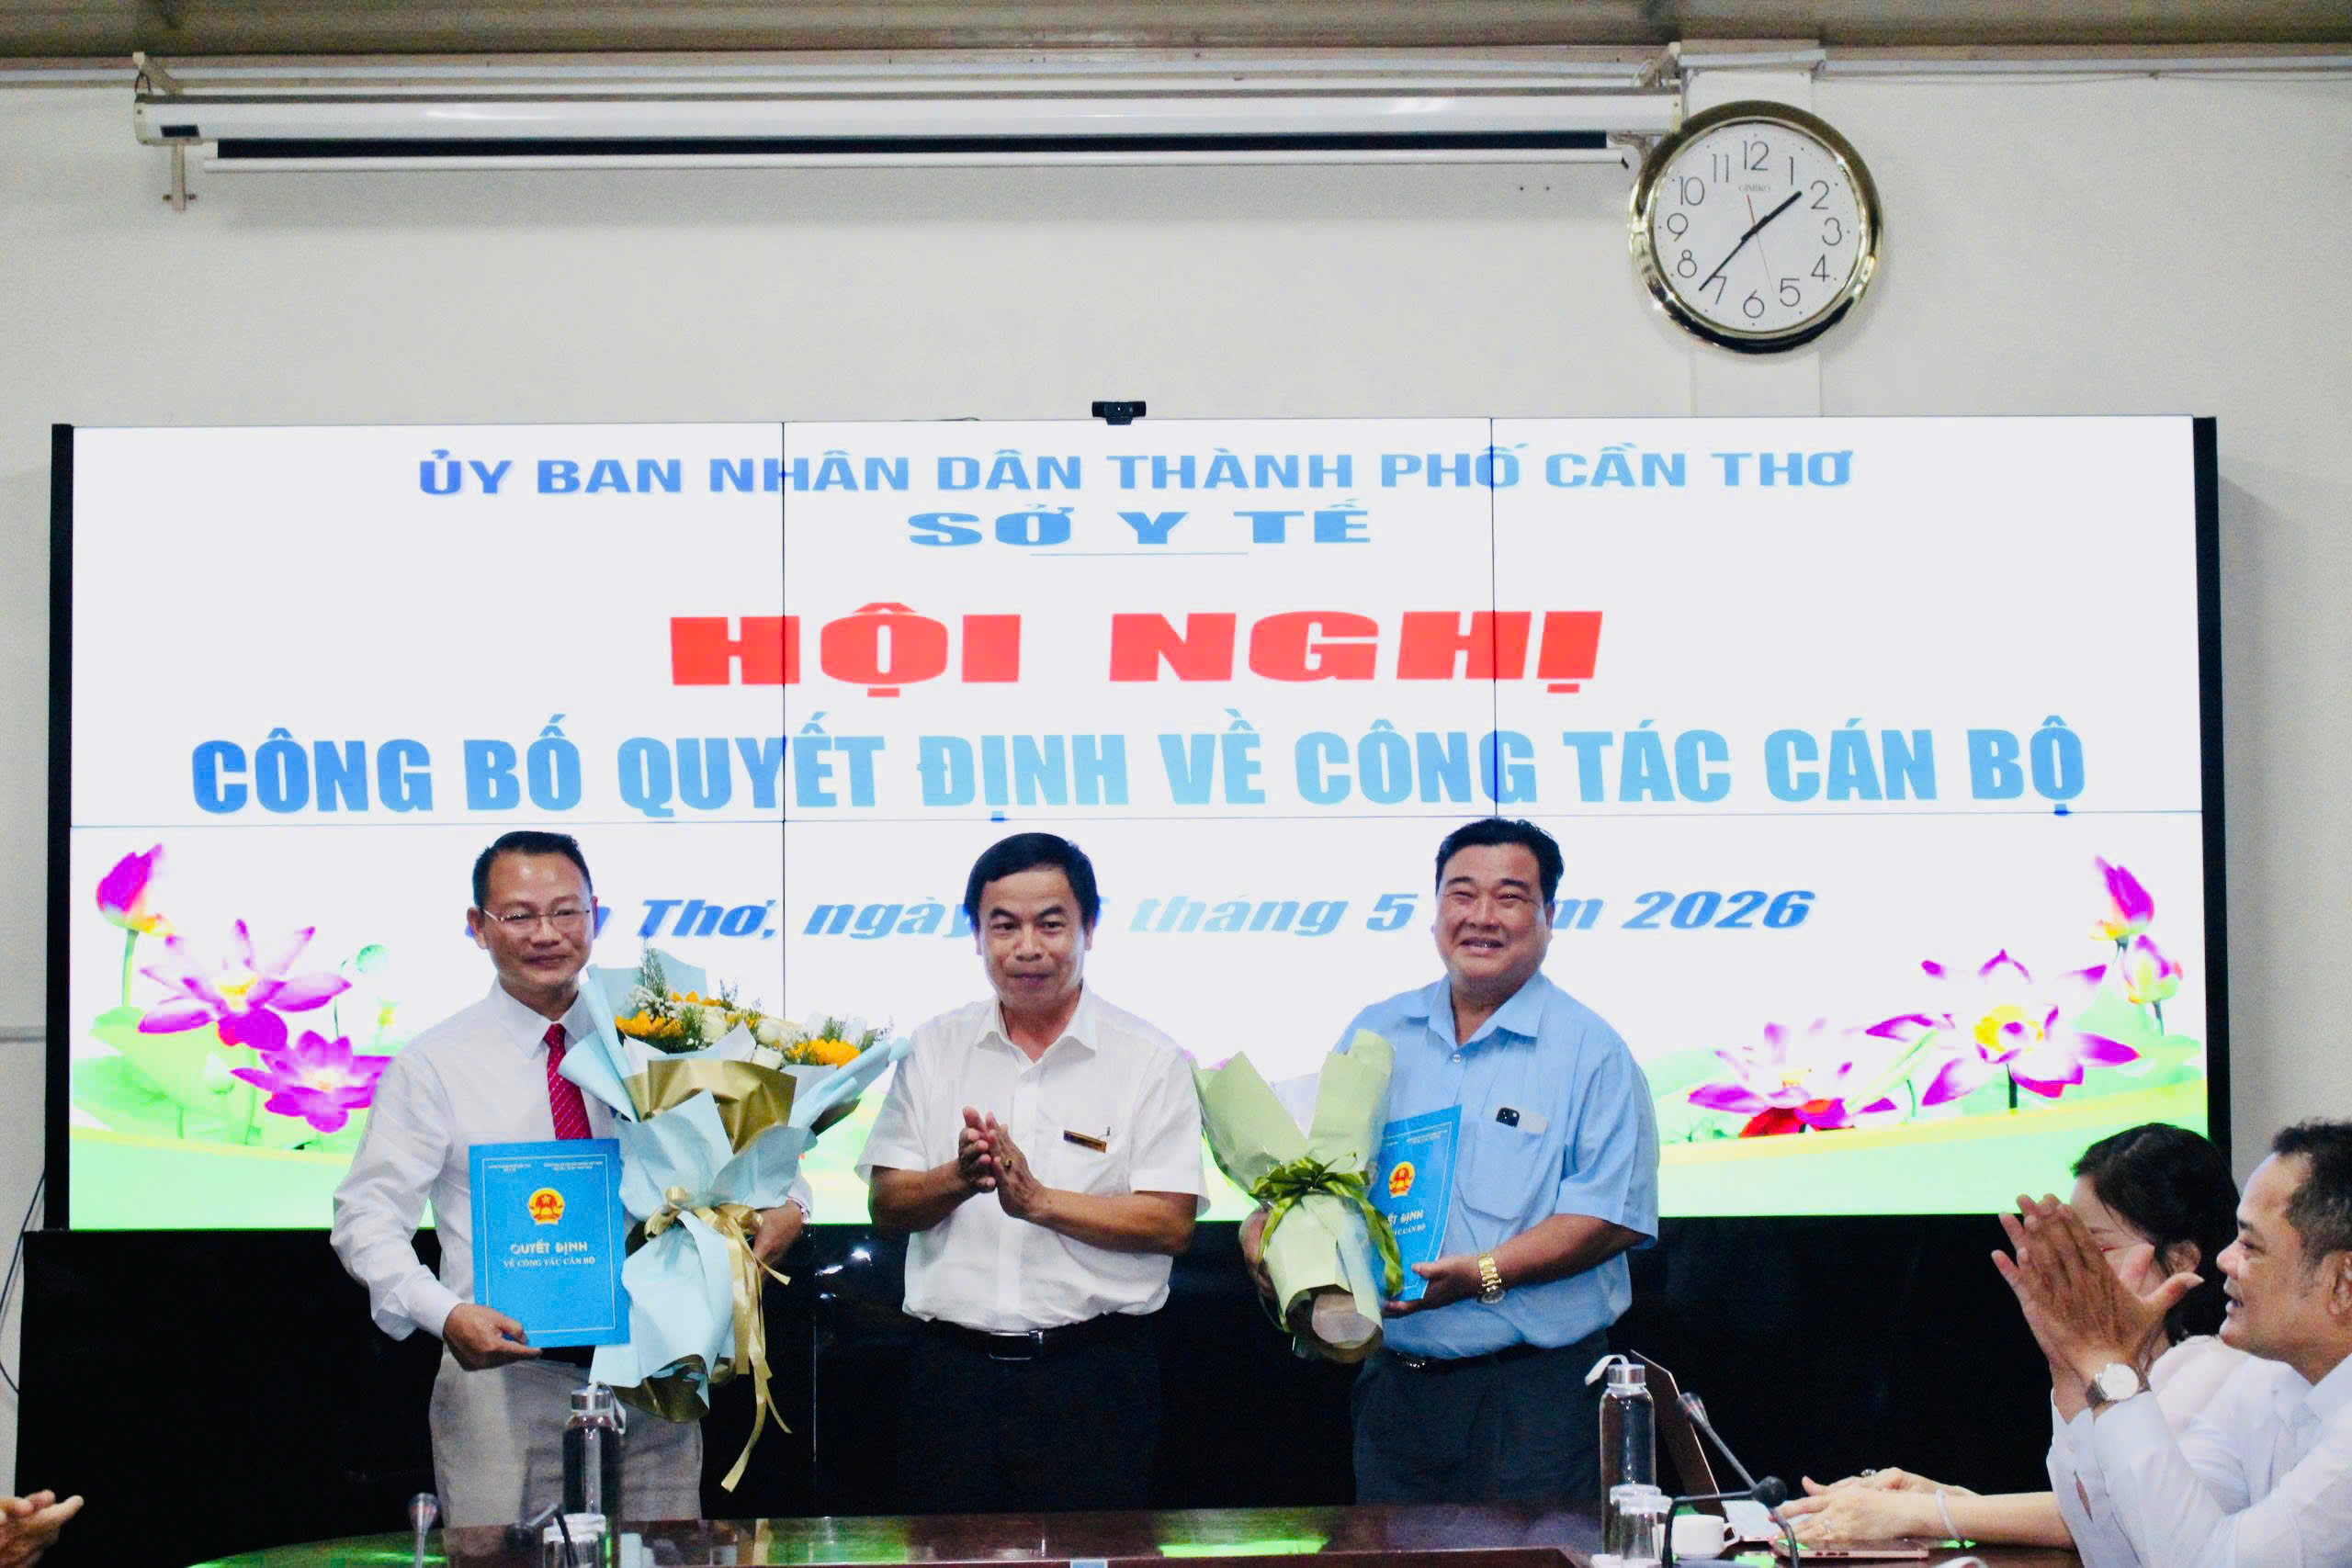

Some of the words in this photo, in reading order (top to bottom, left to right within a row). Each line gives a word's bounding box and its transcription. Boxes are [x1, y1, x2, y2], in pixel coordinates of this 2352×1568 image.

[1713, 153, 1729, 183] 11
[1744, 140, 1769, 171] 12
[1679, 175, 1705, 206] 10
[1810, 180, 1829, 209] 2
[1667, 213, 1689, 242] 9
[1822, 217, 1842, 246] 3
[1677, 250, 1697, 278] 8
[1811, 254, 1830, 282] 4
[1711, 275, 1727, 305] 7
[1743, 289, 1765, 319] 6
[1779, 278, 1801, 307] 5
[419, 448, 512, 496] ỦY
[537, 457, 682, 494] BAN
[709, 450, 910, 492] NHÂN
[937, 449, 1082, 491] DÂN
[1107, 448, 1352, 490] THÀNH
[1382, 442, 1529, 489] PHỐ
[1545, 443, 1687, 488] CẦN
[1712, 450, 1854, 487] THƠ
[907, 503, 1075, 547] SỞ
[1116, 512, 1189, 545] Y
[1234, 499, 1371, 544] TẾ
[669, 603, 1023, 698] HỘI
[1108, 610, 1603, 694] NGHỊ
[191, 728, 434, 815] CÔNG
[463, 713, 582, 812] BỐ
[617, 712, 886, 818] QUYẾT
[917, 735, 1129, 823] ĐỊNH
[1158, 708, 1265, 805] VỀ
[1295, 720, 1537, 806] CÔNG
[1563, 718, 1732, 803] TÁC
[1764, 717, 1938, 803] CÁN
[1966, 715, 2086, 818] BỘ
[638, 898, 776, 941] Thơ,
[1131, 891, 1349, 937] tháng
[1366, 894, 1419, 931] 5
[1622, 889, 1816, 930] 2026
